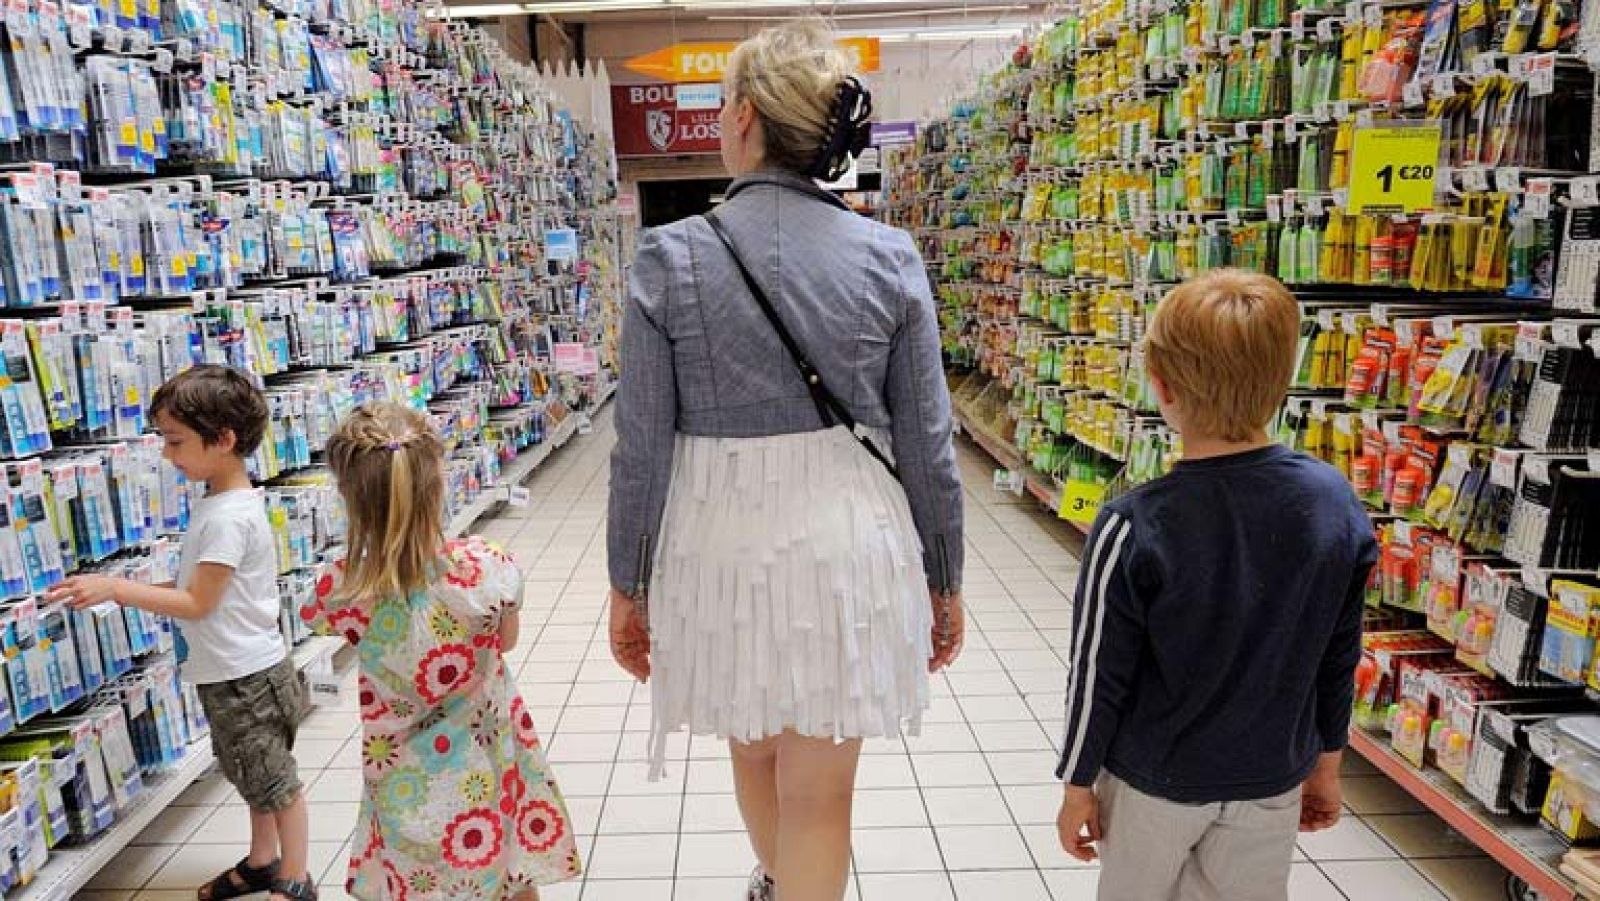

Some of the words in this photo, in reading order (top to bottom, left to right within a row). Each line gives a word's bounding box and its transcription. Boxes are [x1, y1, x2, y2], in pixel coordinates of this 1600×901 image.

[682, 52, 734, 73] FOU
[630, 86, 677, 104] BOU
[680, 122, 721, 140] LOS
